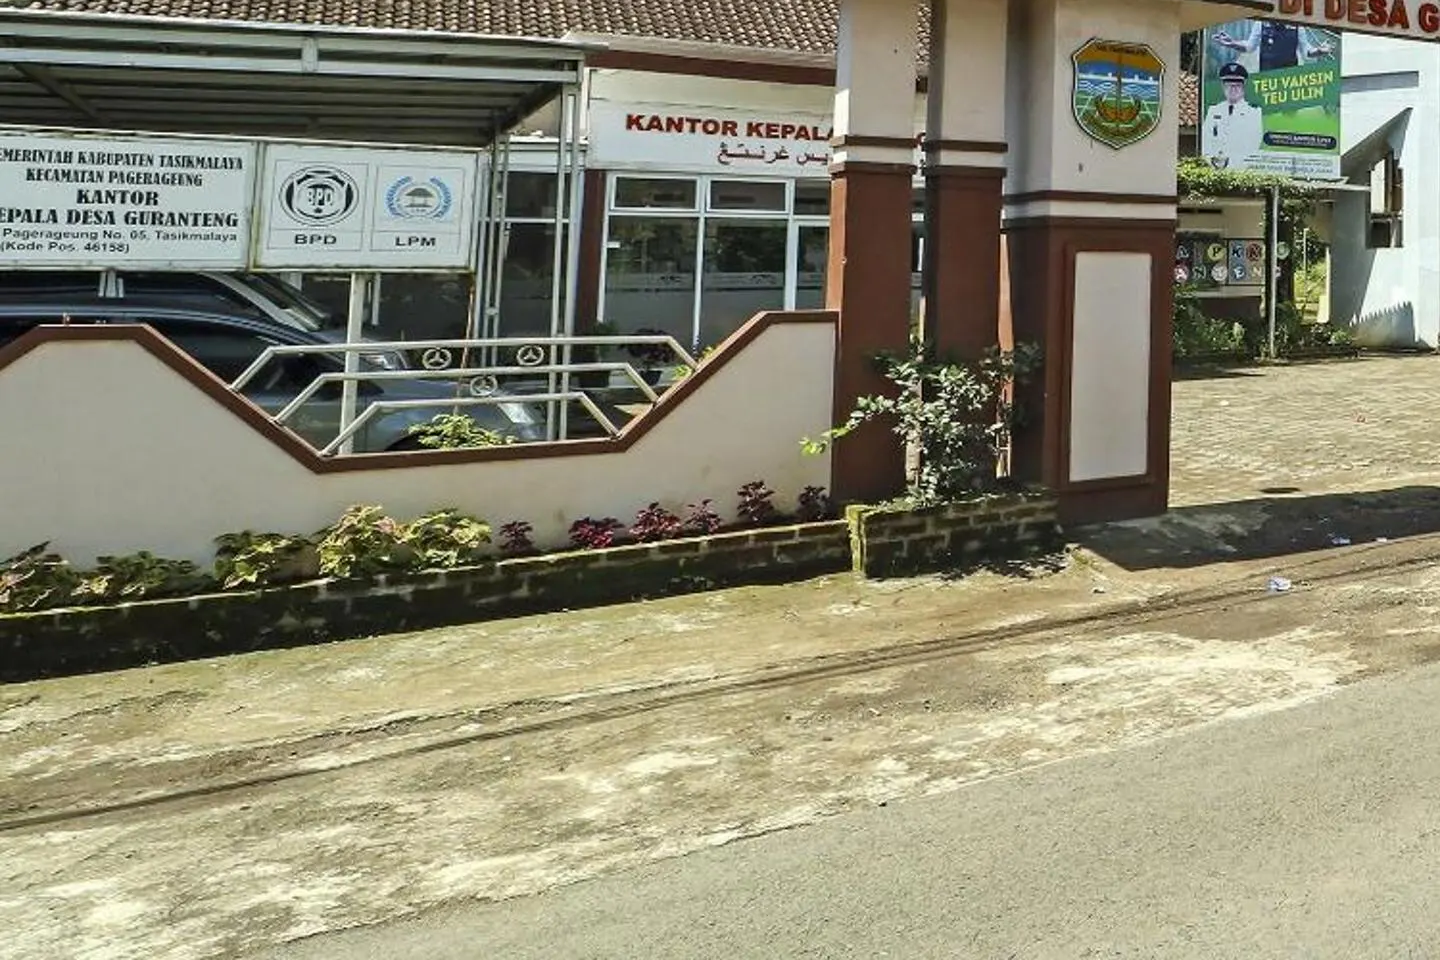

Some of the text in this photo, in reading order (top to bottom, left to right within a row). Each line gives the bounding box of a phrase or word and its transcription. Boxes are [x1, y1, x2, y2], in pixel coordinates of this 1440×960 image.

[1253, 71, 1333, 93] TEU VAKSIN
[1262, 86, 1324, 104] TEU ULIN
[626, 114, 738, 137] KANTOR
[0, 147, 243, 170] EMERINTAH KABUPATEN TASIKMALAYA
[26, 168, 104, 183] KECAMATAN
[76, 189, 159, 206] KANTOR
[0, 208, 238, 228] EPALA DESA GURANTENG
[3, 228, 99, 241] Pagerageung
[155, 230, 237, 242] Tasikmalaya
[294, 234, 337, 245] BPD
[395, 236, 437, 247] LPM
